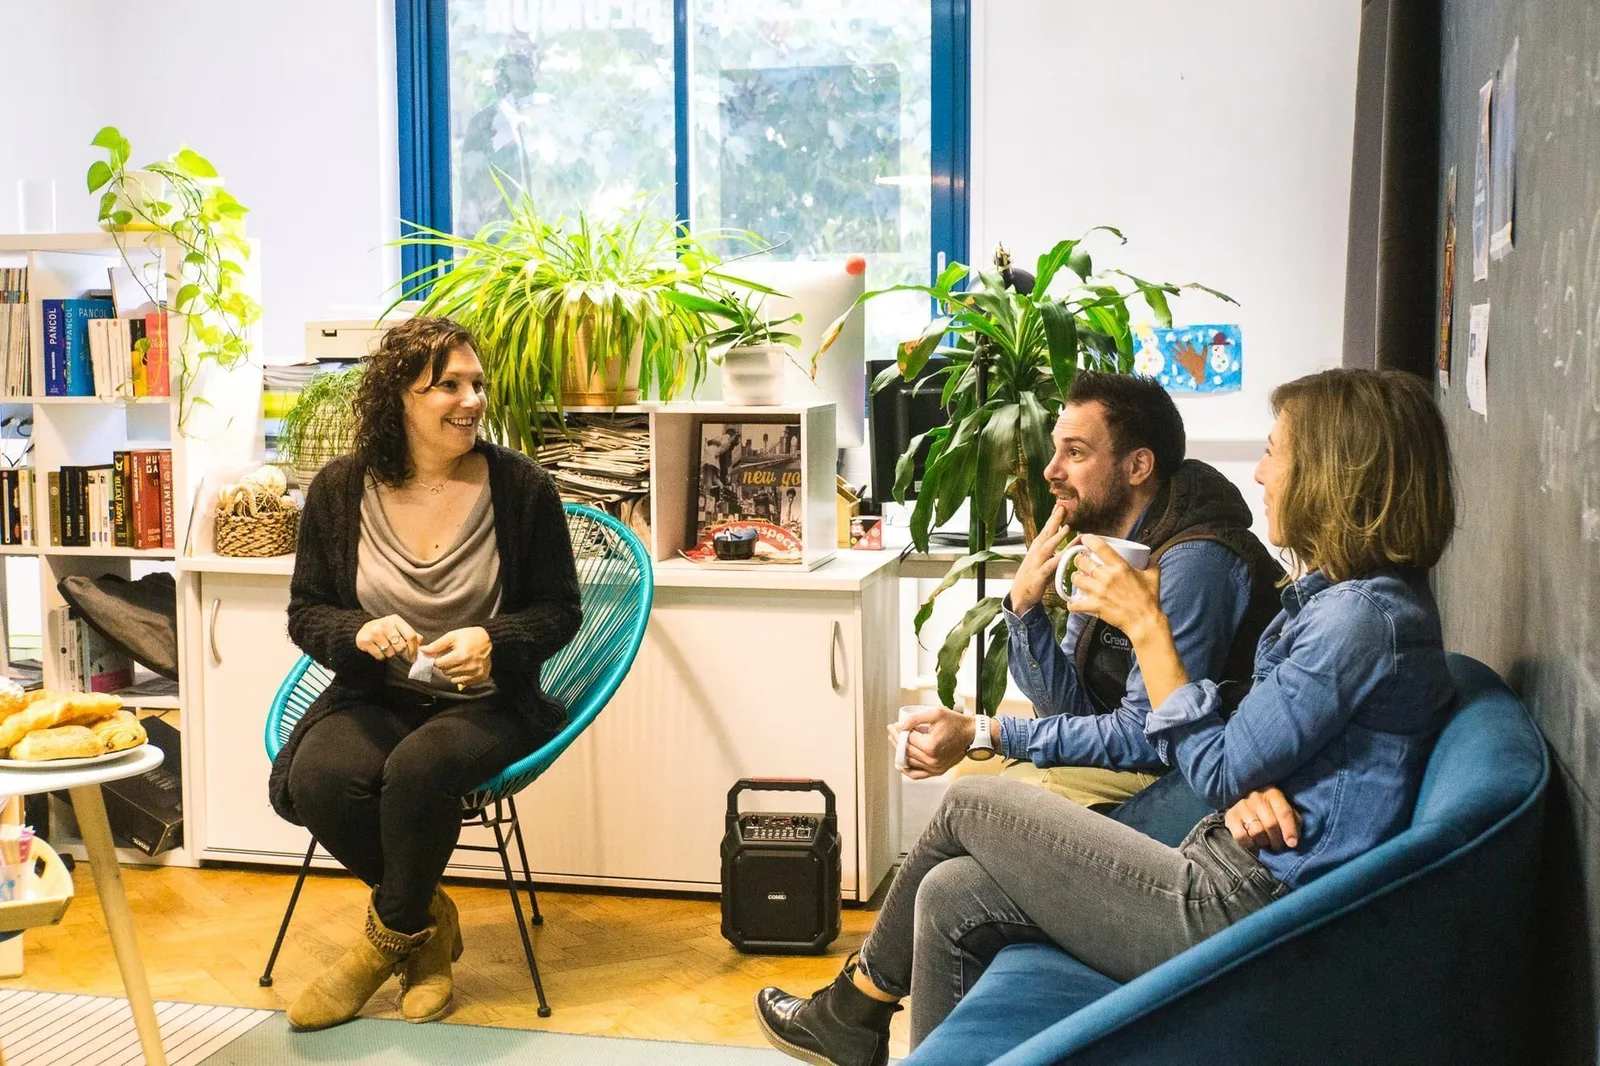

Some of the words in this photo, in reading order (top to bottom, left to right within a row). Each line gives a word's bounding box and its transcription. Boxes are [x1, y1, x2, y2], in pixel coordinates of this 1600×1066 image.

[78, 307, 108, 318] PANCOL
[114, 475, 123, 501] POTTER
[742, 470, 776, 484] new
[115, 501, 124, 525] HARRY
[163, 483, 173, 538] ENDGAME
